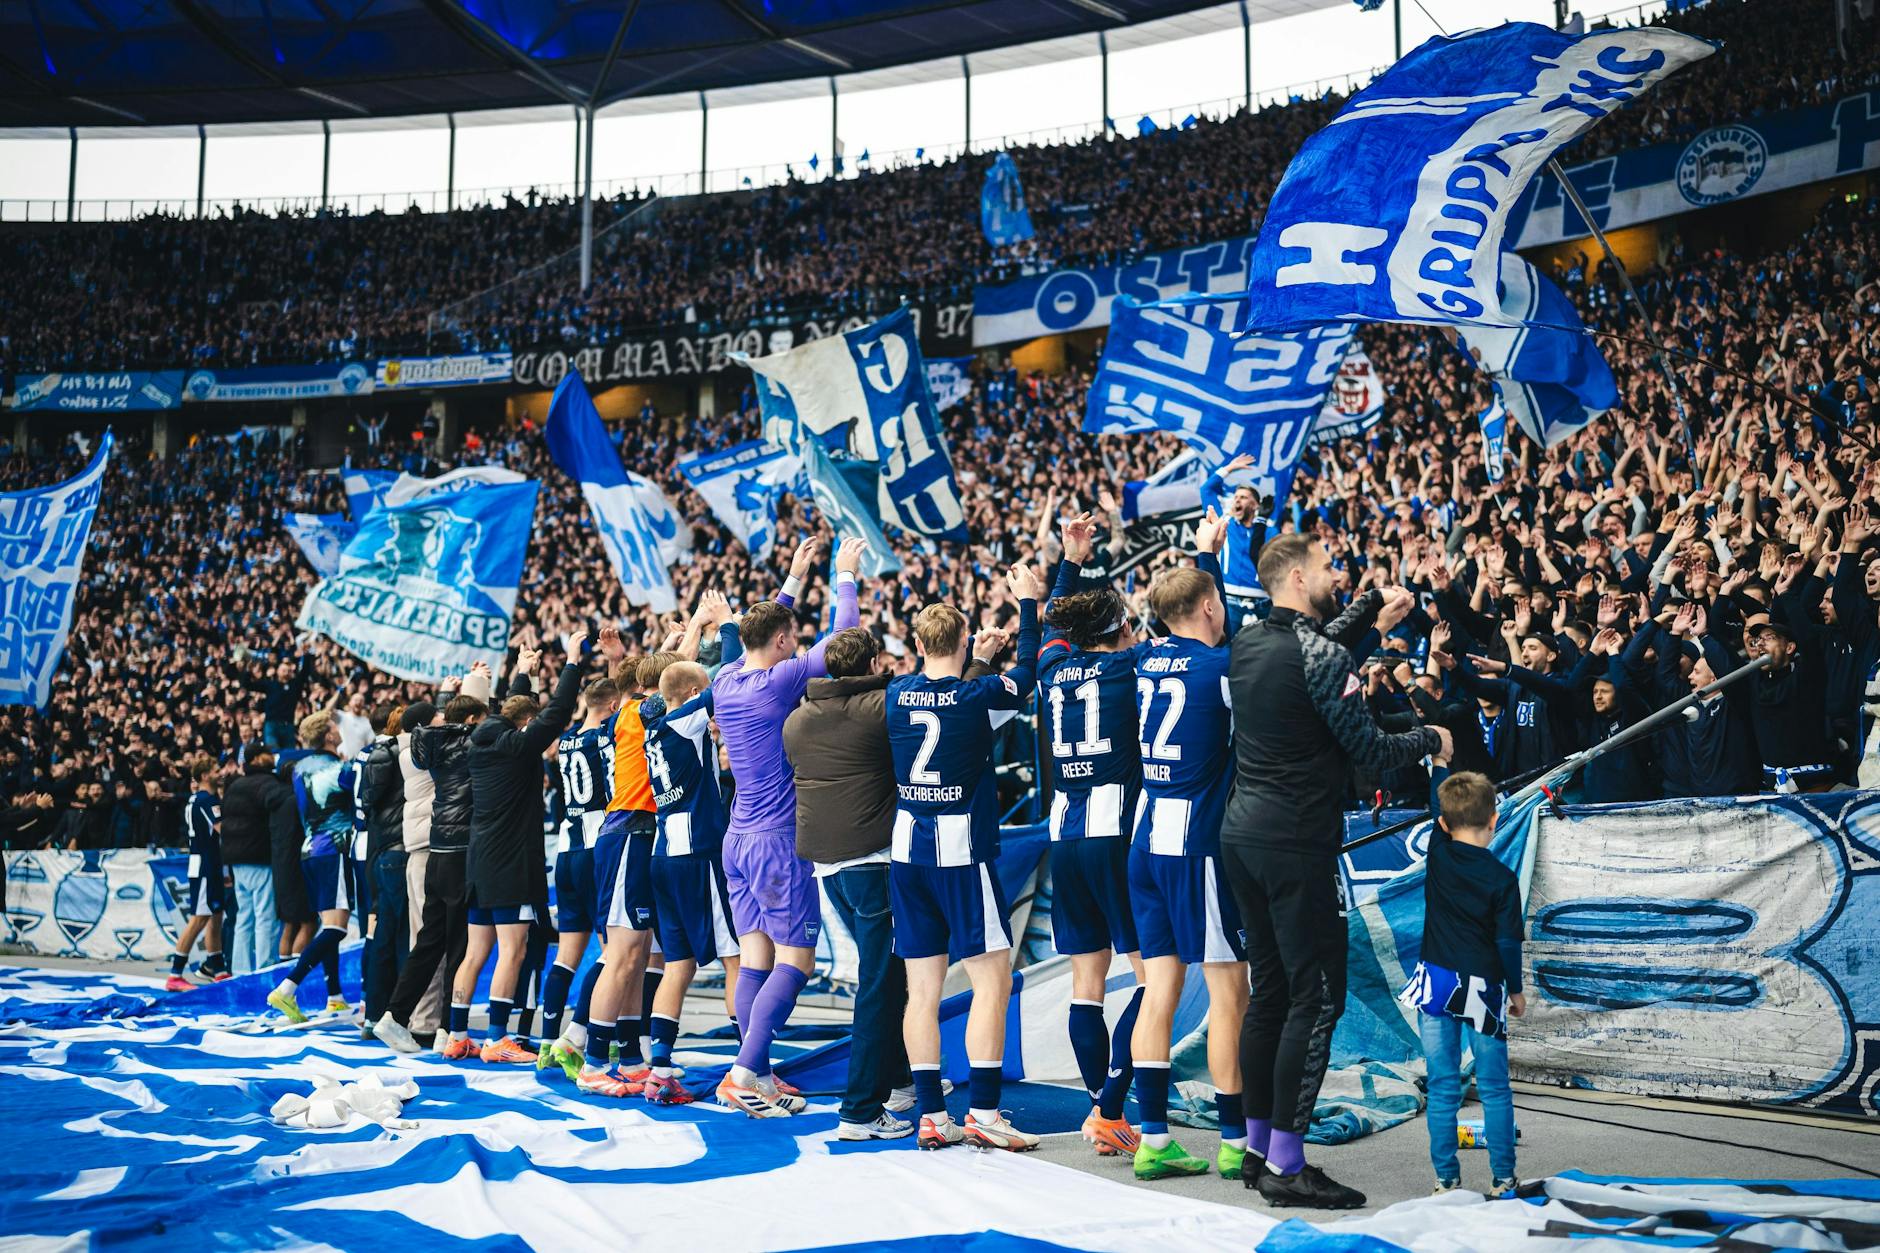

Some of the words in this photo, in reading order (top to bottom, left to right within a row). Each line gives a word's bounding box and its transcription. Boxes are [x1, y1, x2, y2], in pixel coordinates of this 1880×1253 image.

[513, 330, 763, 387] COMMANDO
[1170, 657, 1192, 673] BSC
[897, 690, 935, 707] HERTHA
[937, 690, 958, 707] BSC
[1048, 679, 1112, 758] 11
[1137, 677, 1187, 760] 22
[909, 710, 941, 785] 2
[1062, 762, 1094, 778] REESE
